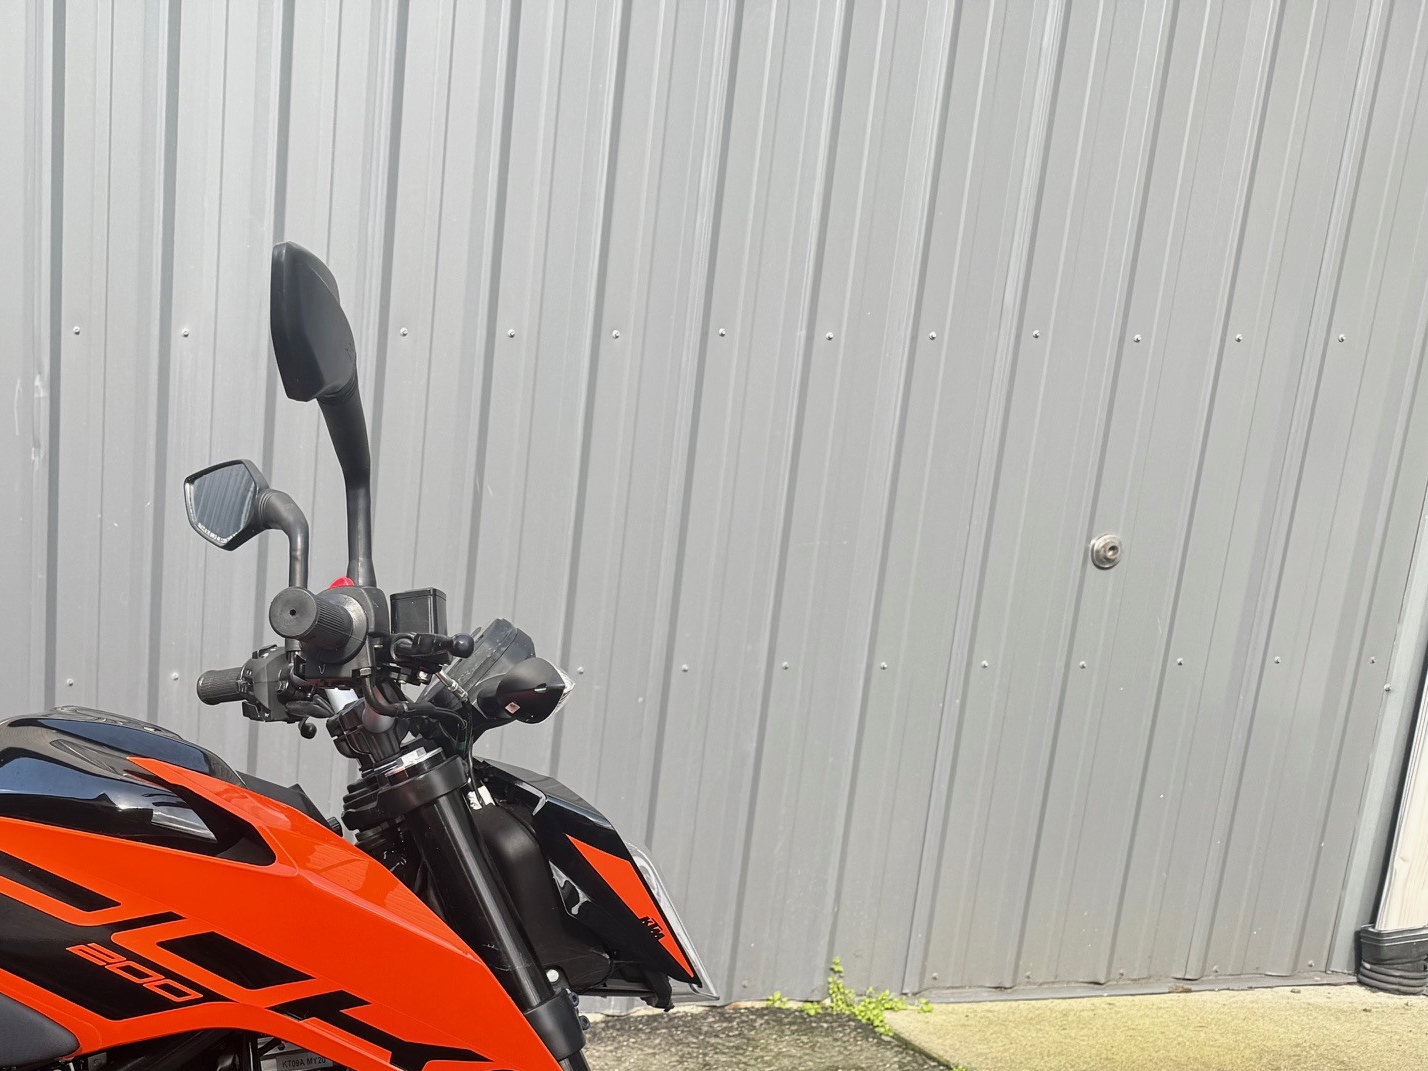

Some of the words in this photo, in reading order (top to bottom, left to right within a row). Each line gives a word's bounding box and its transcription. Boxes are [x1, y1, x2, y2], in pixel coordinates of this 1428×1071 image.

[638, 915, 665, 941] KTM
[66, 942, 203, 1002] 200
[282, 1059, 305, 1068] KT09A
[307, 1056, 327, 1066] MY20
